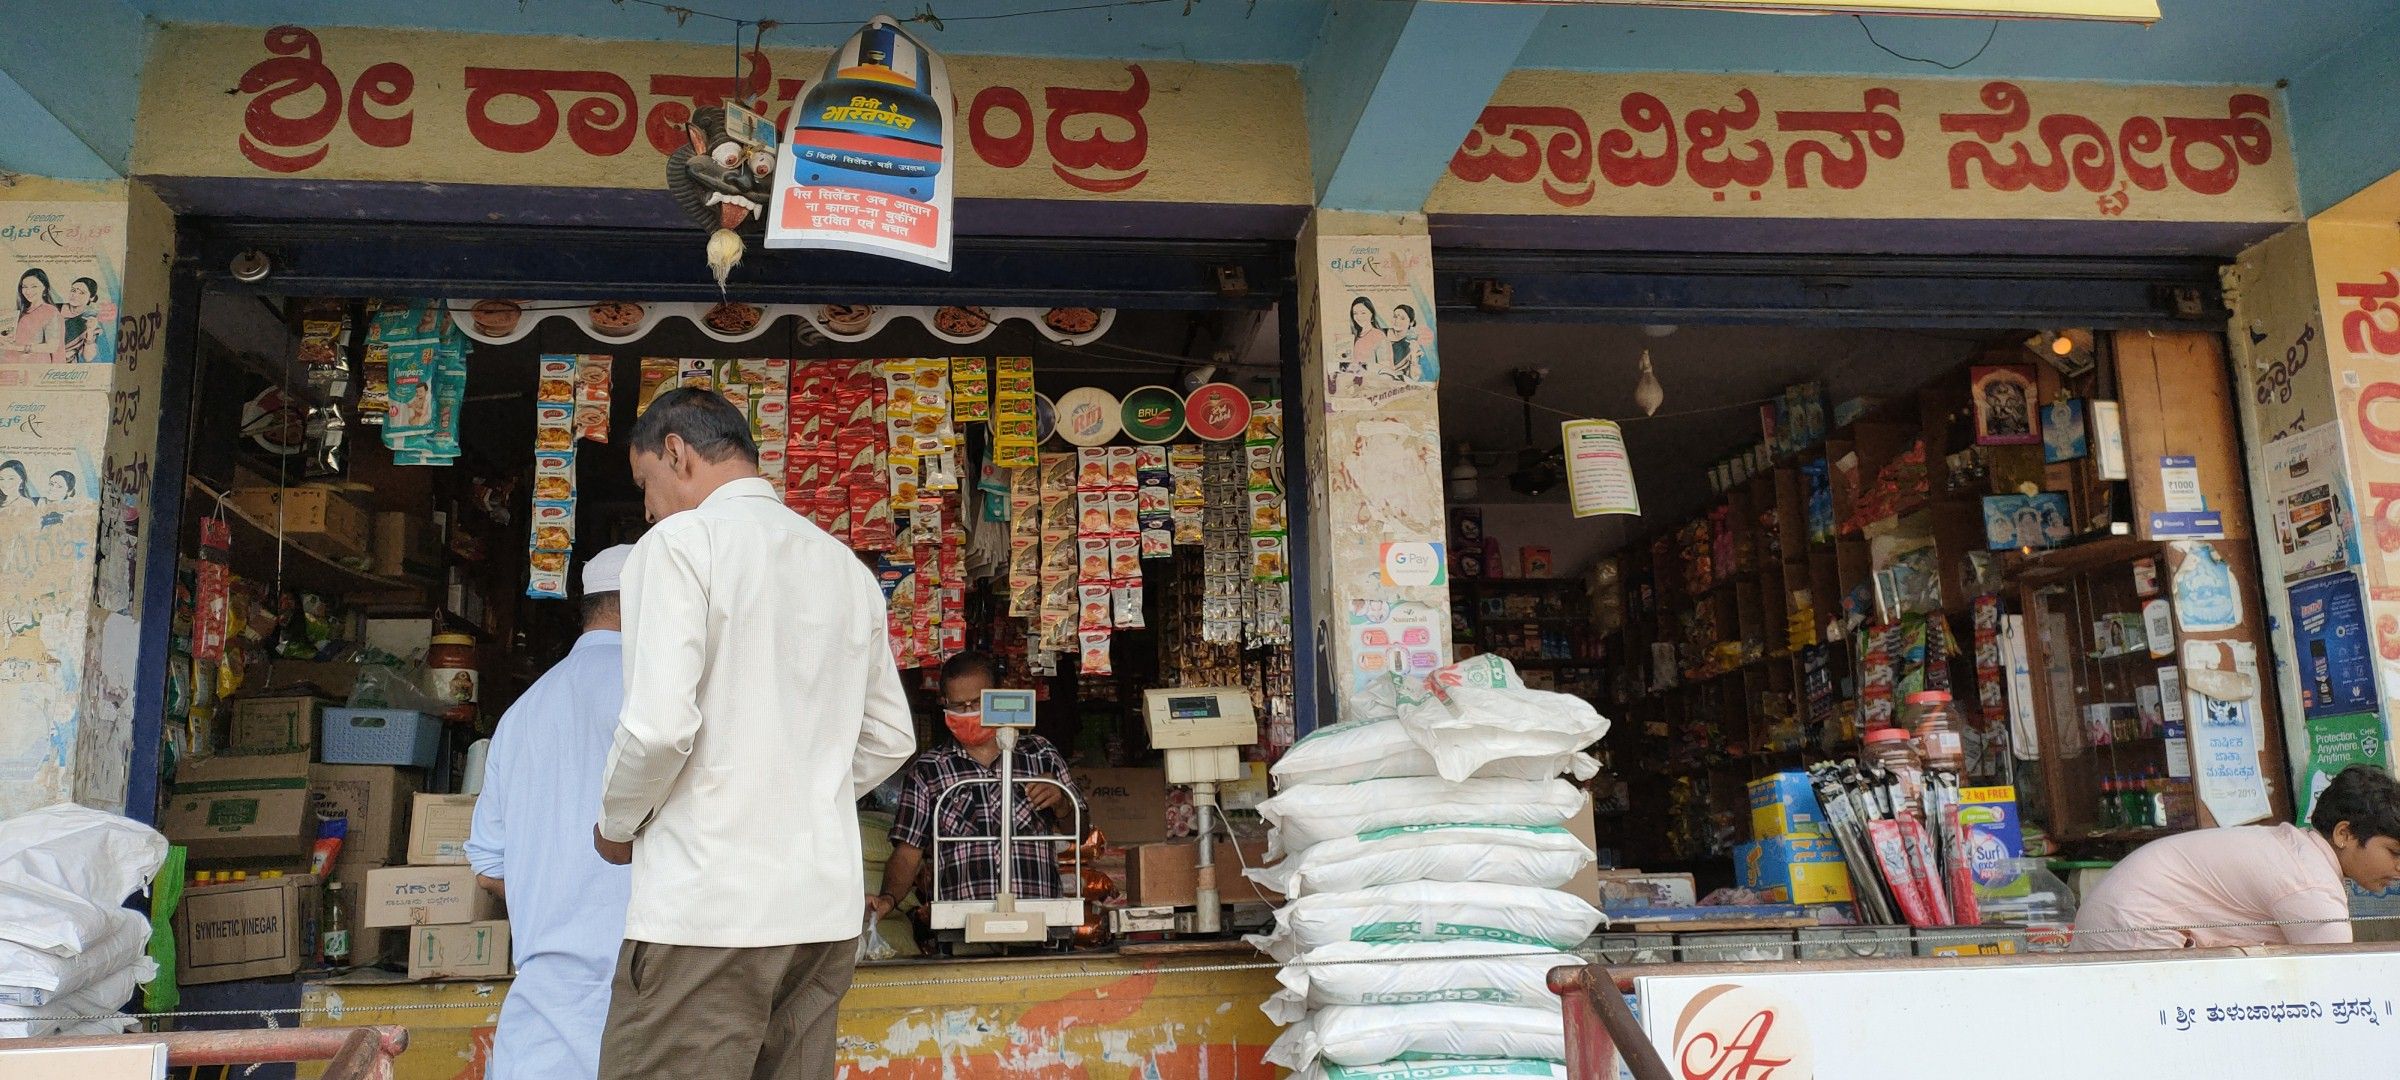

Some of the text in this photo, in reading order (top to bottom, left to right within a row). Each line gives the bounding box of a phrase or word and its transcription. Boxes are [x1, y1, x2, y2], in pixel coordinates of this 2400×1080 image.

[239, 25, 414, 172] ಶ್ರೀ
[805, 150, 814, 158] 5
[1940, 81, 2272, 216] ಸ್ಟೋರ್
[865, 194, 888, 207] अब
[26, 211, 65, 222] Freedom
[42, 368, 89, 381] Freedom
[7, 401, 46, 412] Freedom
[1138, 408, 1158, 418] BRU
[1409, 553, 1429, 568] Pay
[2316, 732, 2358, 743] Protection.
[2318, 742, 2360, 754] Anywhere.
[2317, 753, 2353, 763] Anytime.
[1092, 787, 1129, 797] ARIEL
[1966, 791, 1971, 800] 2
[1975, 790, 1985, 801] kg
[1977, 847, 2000, 859] Surf
[195, 916, 278, 940] SYNTHETIC VINEGAR
[2176, 1007, 2196, 1031] ಶ್ರೀ
[2206, 1001, 2323, 1023] ತುಳುಜಾಭವಾನಿ
[2332, 997, 2380, 1025] ಪ್ರಸನ್ನ
